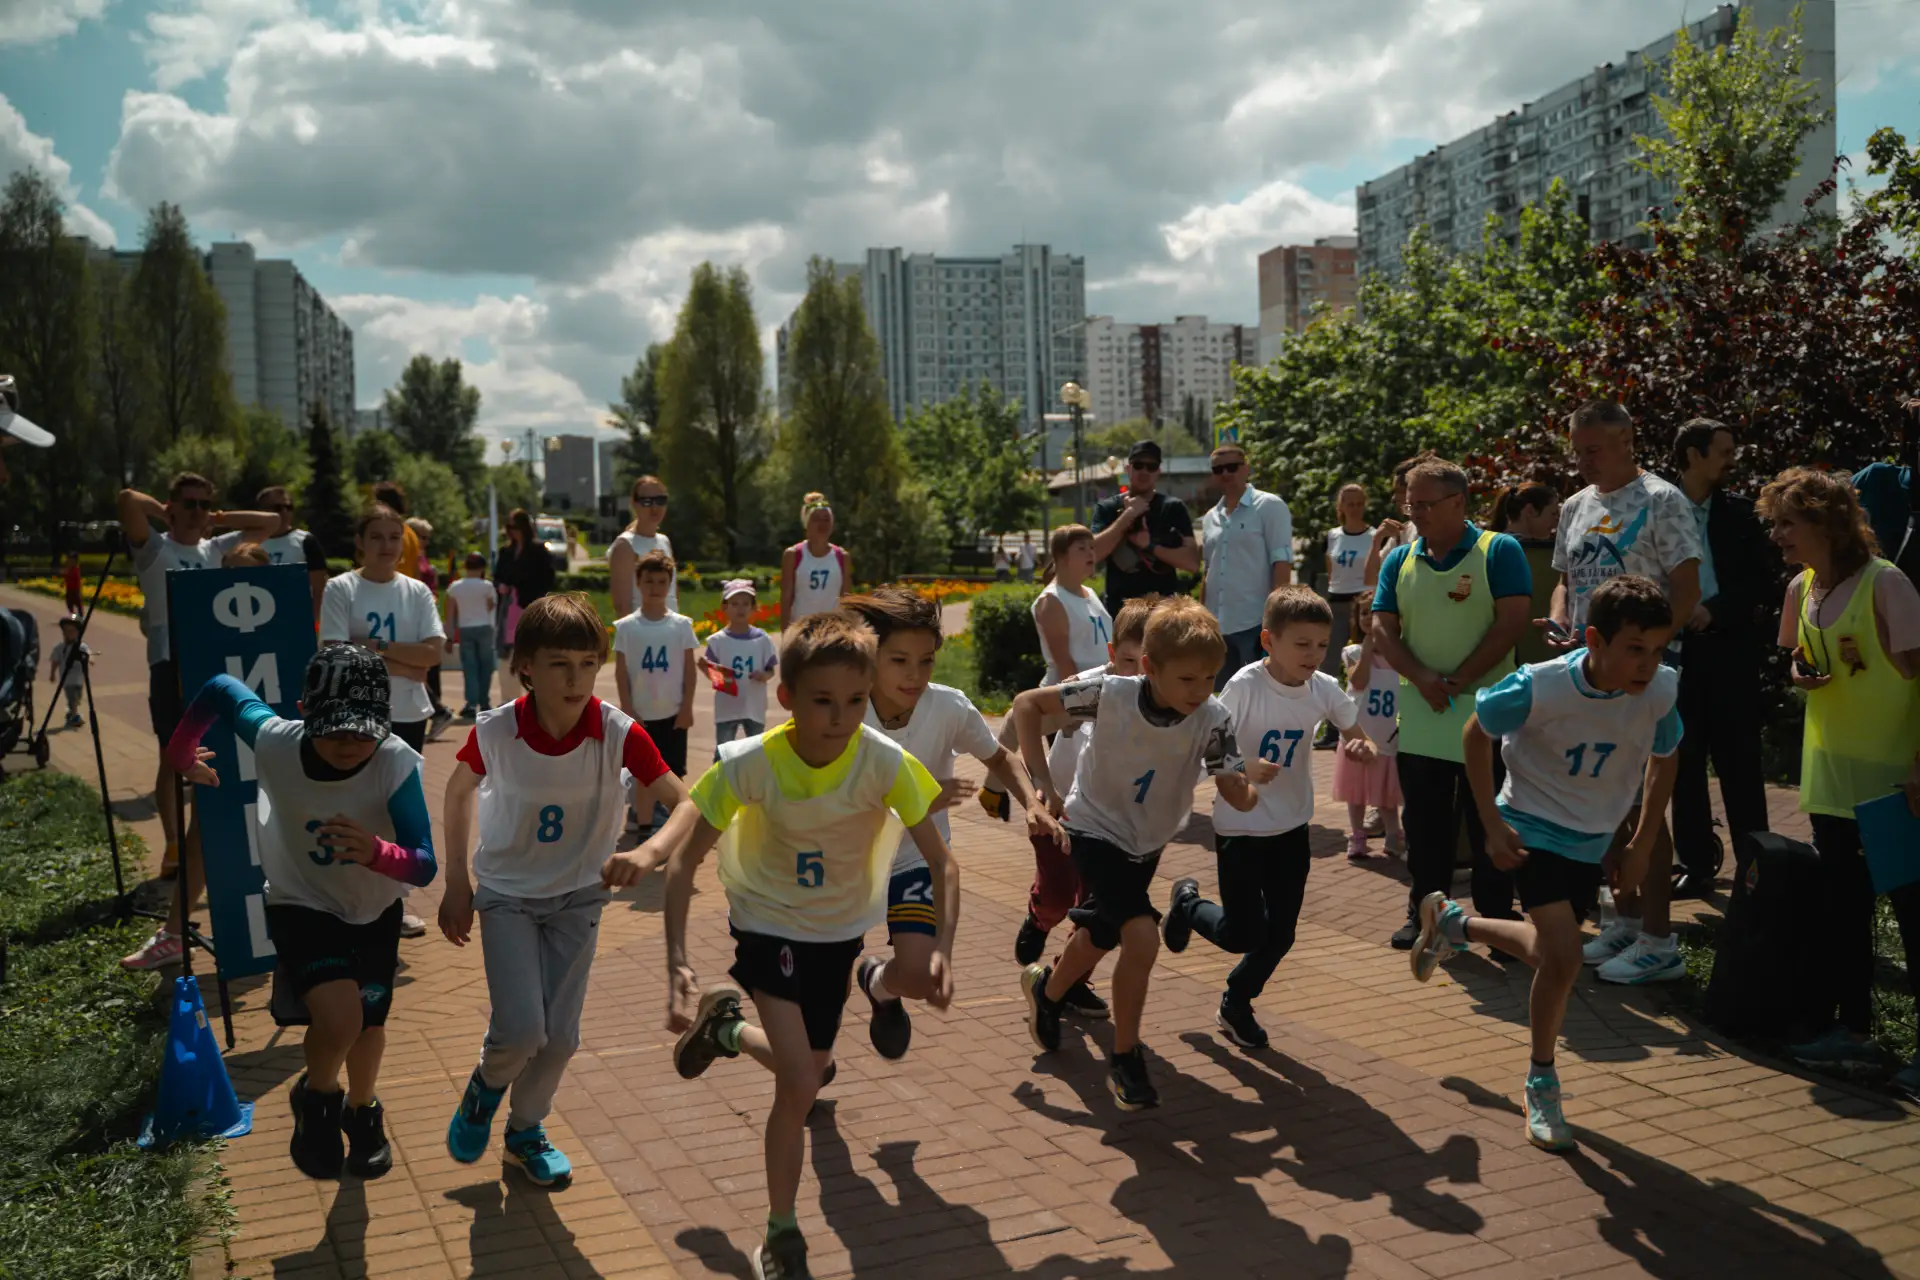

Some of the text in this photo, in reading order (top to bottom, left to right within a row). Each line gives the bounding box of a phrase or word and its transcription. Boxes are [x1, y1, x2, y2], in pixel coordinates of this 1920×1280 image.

[1337, 551, 1358, 567] 47
[810, 570, 829, 590] 57
[366, 611, 396, 642] 21
[641, 646, 669, 672] 44
[732, 655, 754, 680] 61
[1367, 689, 1395, 718] 58
[1258, 729, 1305, 768] 67
[1565, 743, 1616, 777] 17
[1133, 769, 1156, 804] 1
[537, 804, 564, 843] 8
[797, 852, 824, 887] 5
